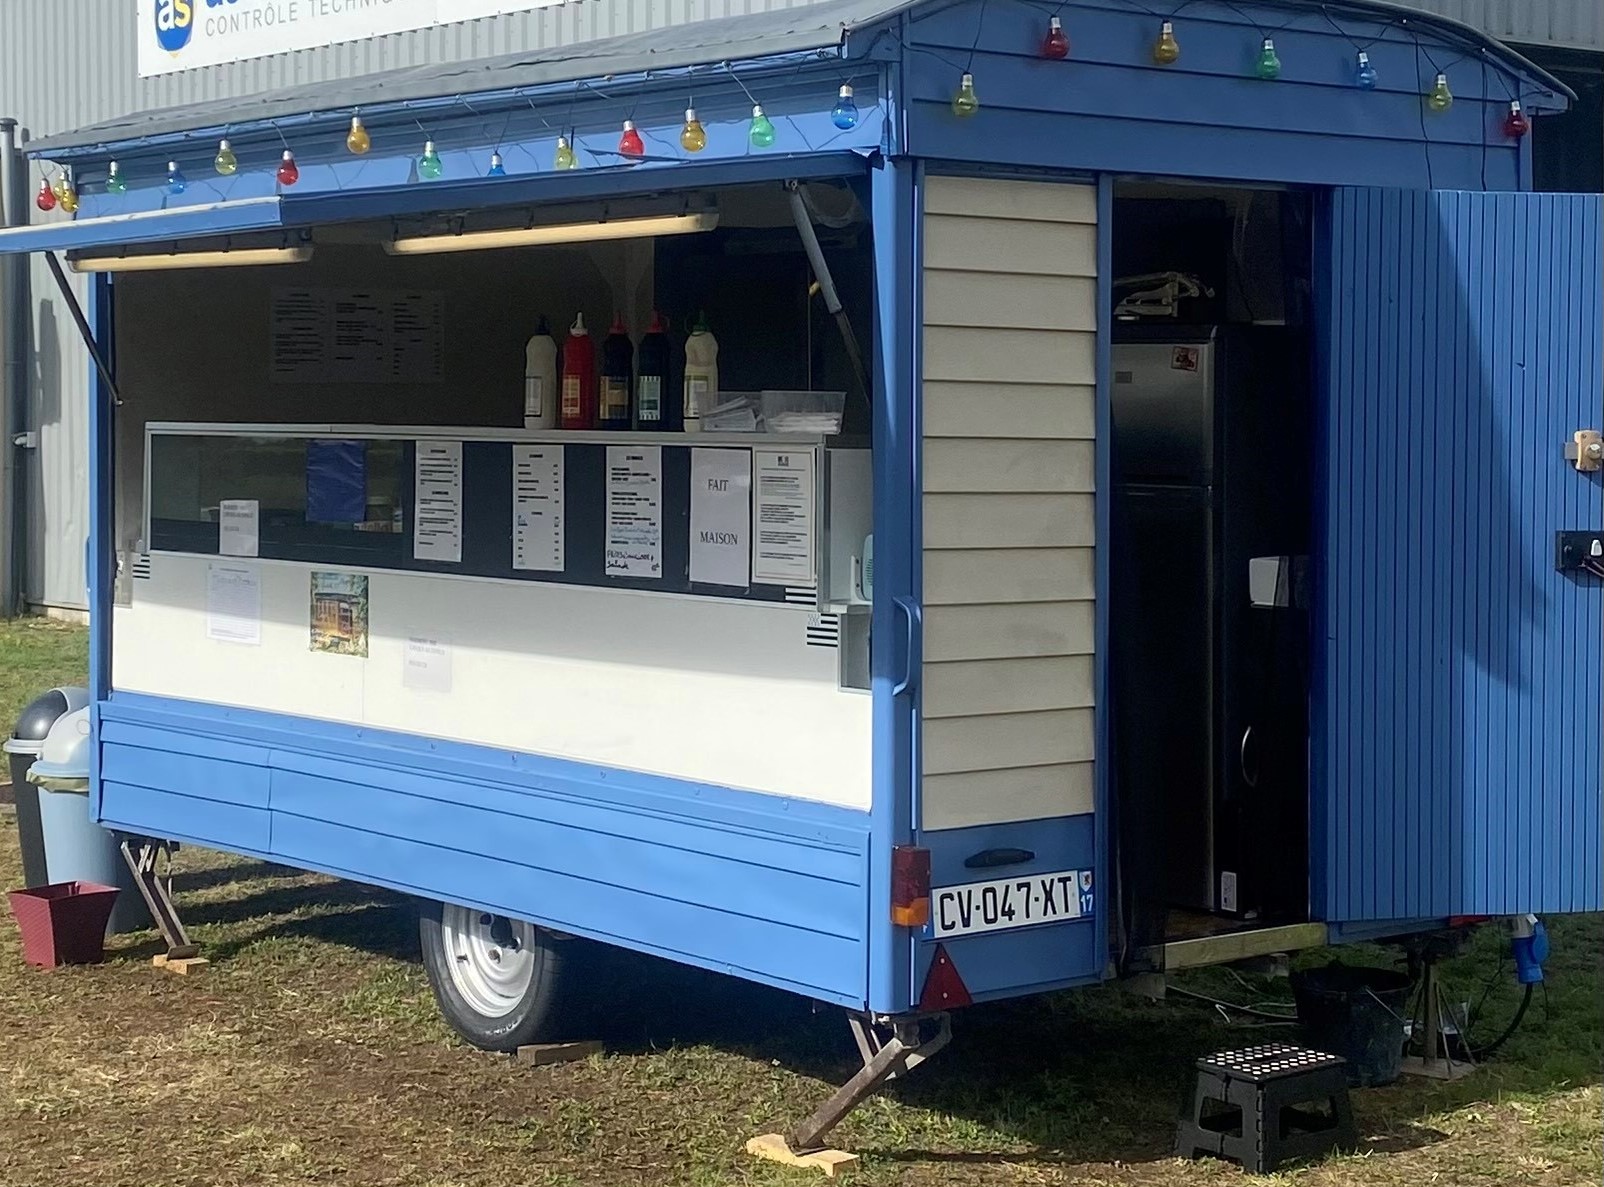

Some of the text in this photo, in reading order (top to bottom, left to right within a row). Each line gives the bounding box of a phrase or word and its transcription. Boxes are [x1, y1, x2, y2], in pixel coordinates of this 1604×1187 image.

[158, 0, 192, 31] as
[205, 2, 299, 37] CONTRÔLE
[707, 478, 729, 492] FAIT
[700, 531, 738, 545] MAISON
[1080, 894, 1094, 913] 17
